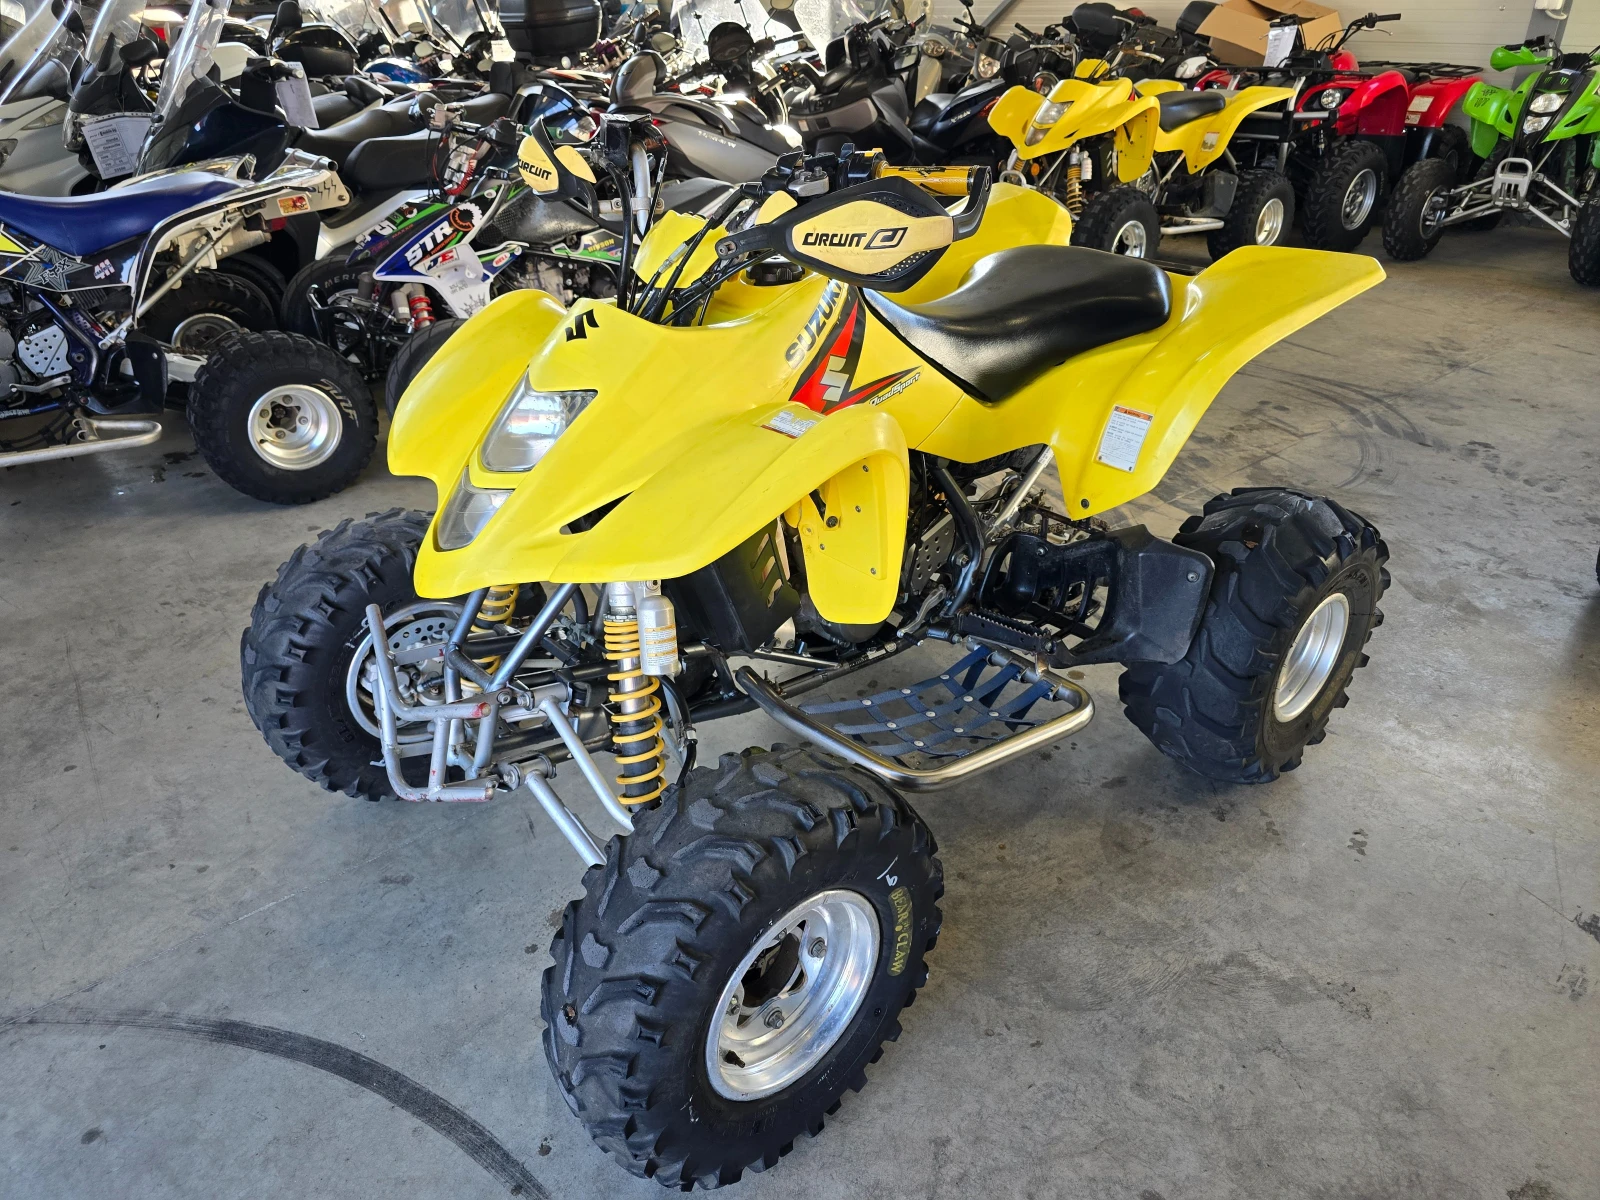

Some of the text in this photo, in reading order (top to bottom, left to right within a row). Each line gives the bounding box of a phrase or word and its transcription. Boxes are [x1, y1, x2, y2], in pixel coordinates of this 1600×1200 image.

[404, 220, 453, 267] STR
[802, 232, 867, 247] CIRCUIT
[784, 278, 843, 371] SUZUK
[890, 888, 910, 973] BEAR CLAW
